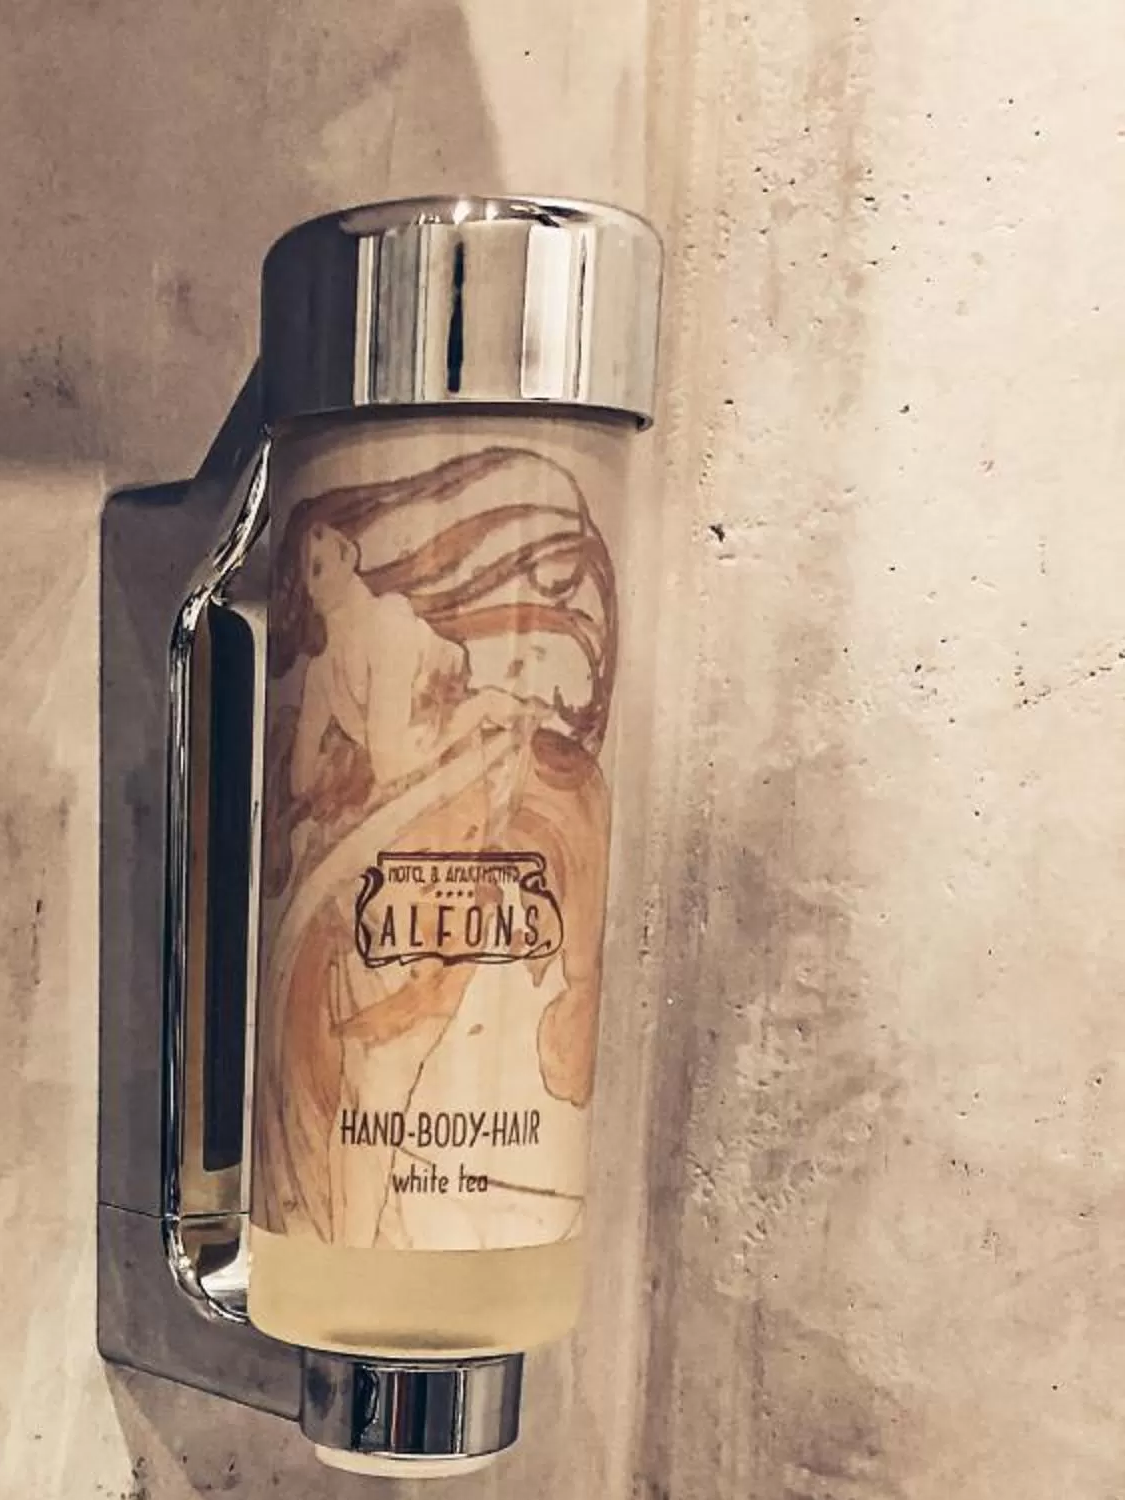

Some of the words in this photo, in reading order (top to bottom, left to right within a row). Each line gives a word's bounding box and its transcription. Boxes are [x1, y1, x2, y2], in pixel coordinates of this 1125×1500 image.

[379, 904, 539, 947] ALFONS
[341, 1109, 540, 1147] HAND-BODY-HAIR
[392, 1163, 449, 1194] white
[458, 1163, 489, 1194] tea
